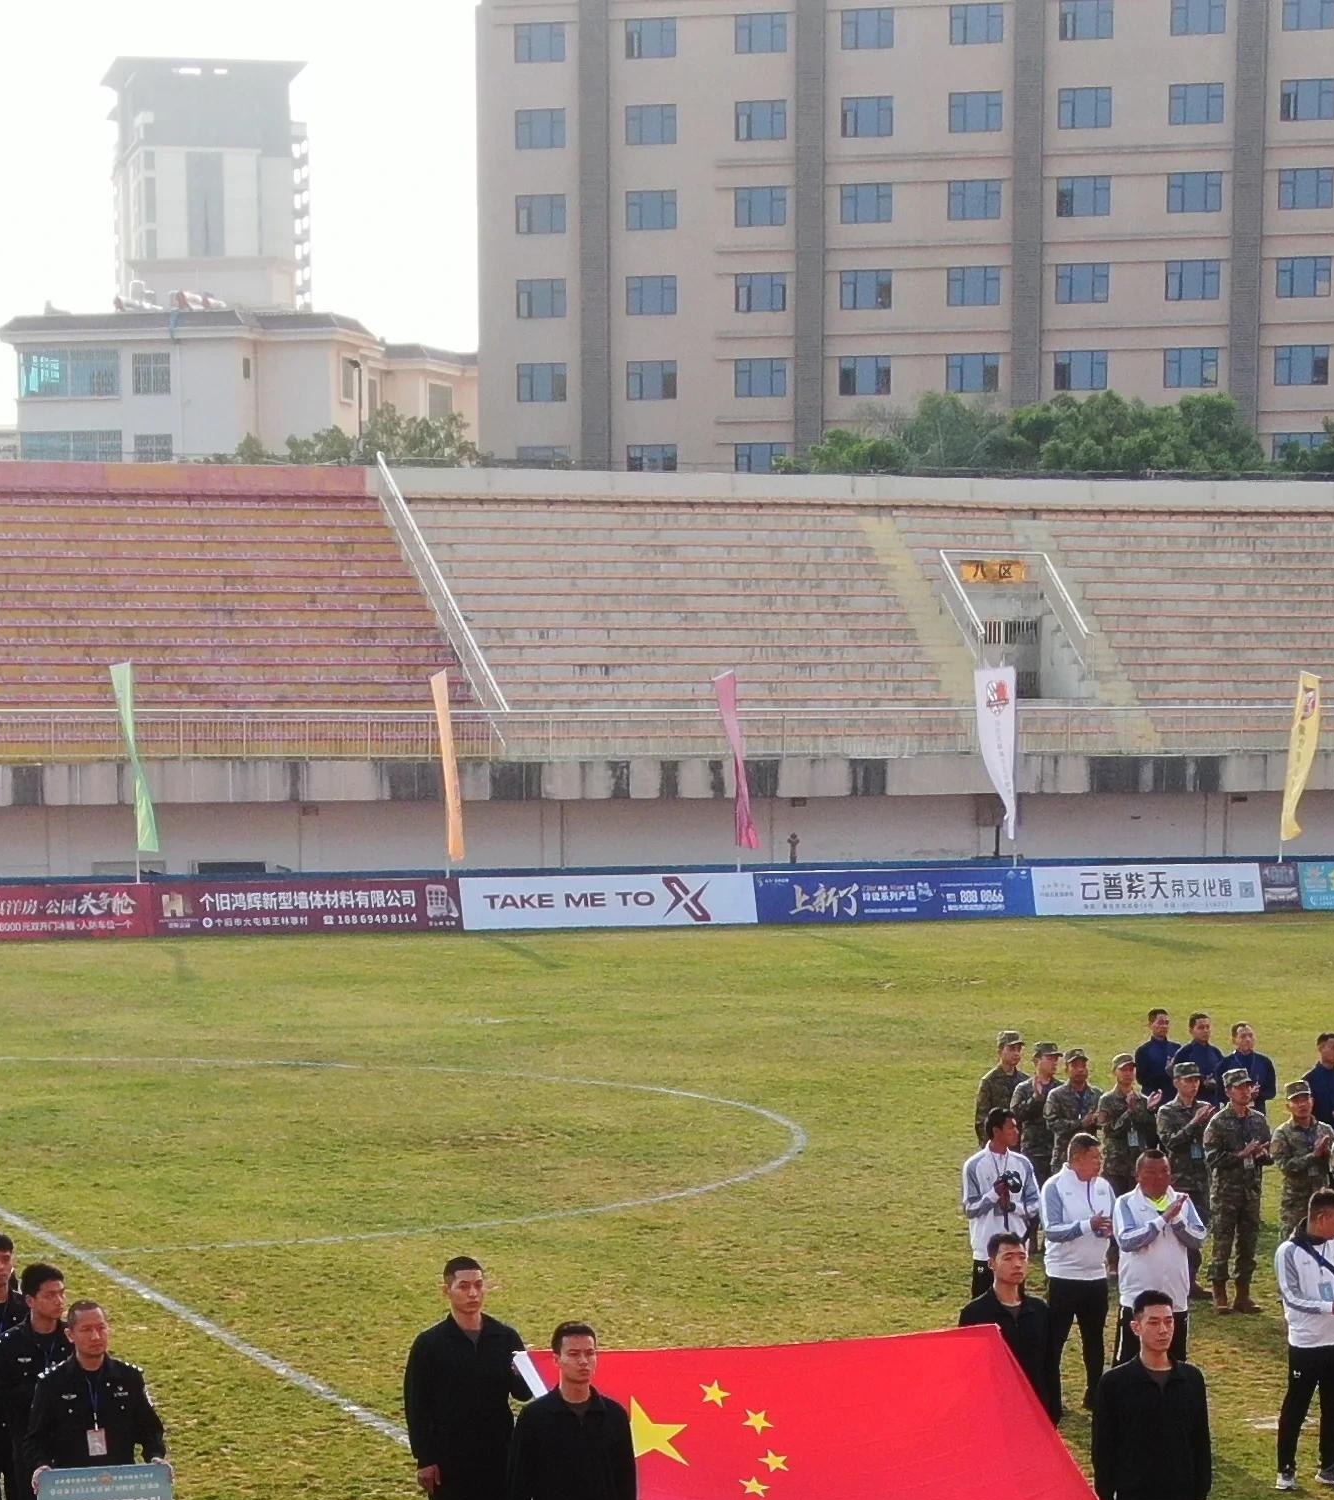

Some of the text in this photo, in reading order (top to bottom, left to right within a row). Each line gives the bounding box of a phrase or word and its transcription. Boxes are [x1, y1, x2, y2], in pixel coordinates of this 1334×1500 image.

[972, 563, 1013, 579] 八区
[199, 889, 417, 912] 个旧鸿辉新型墙体材料有限公司
[483, 893, 554, 910] TAKE
[564, 892, 606, 908] ME
[614, 891, 655, 907] TO
[788, 882, 860, 918] 上新了
